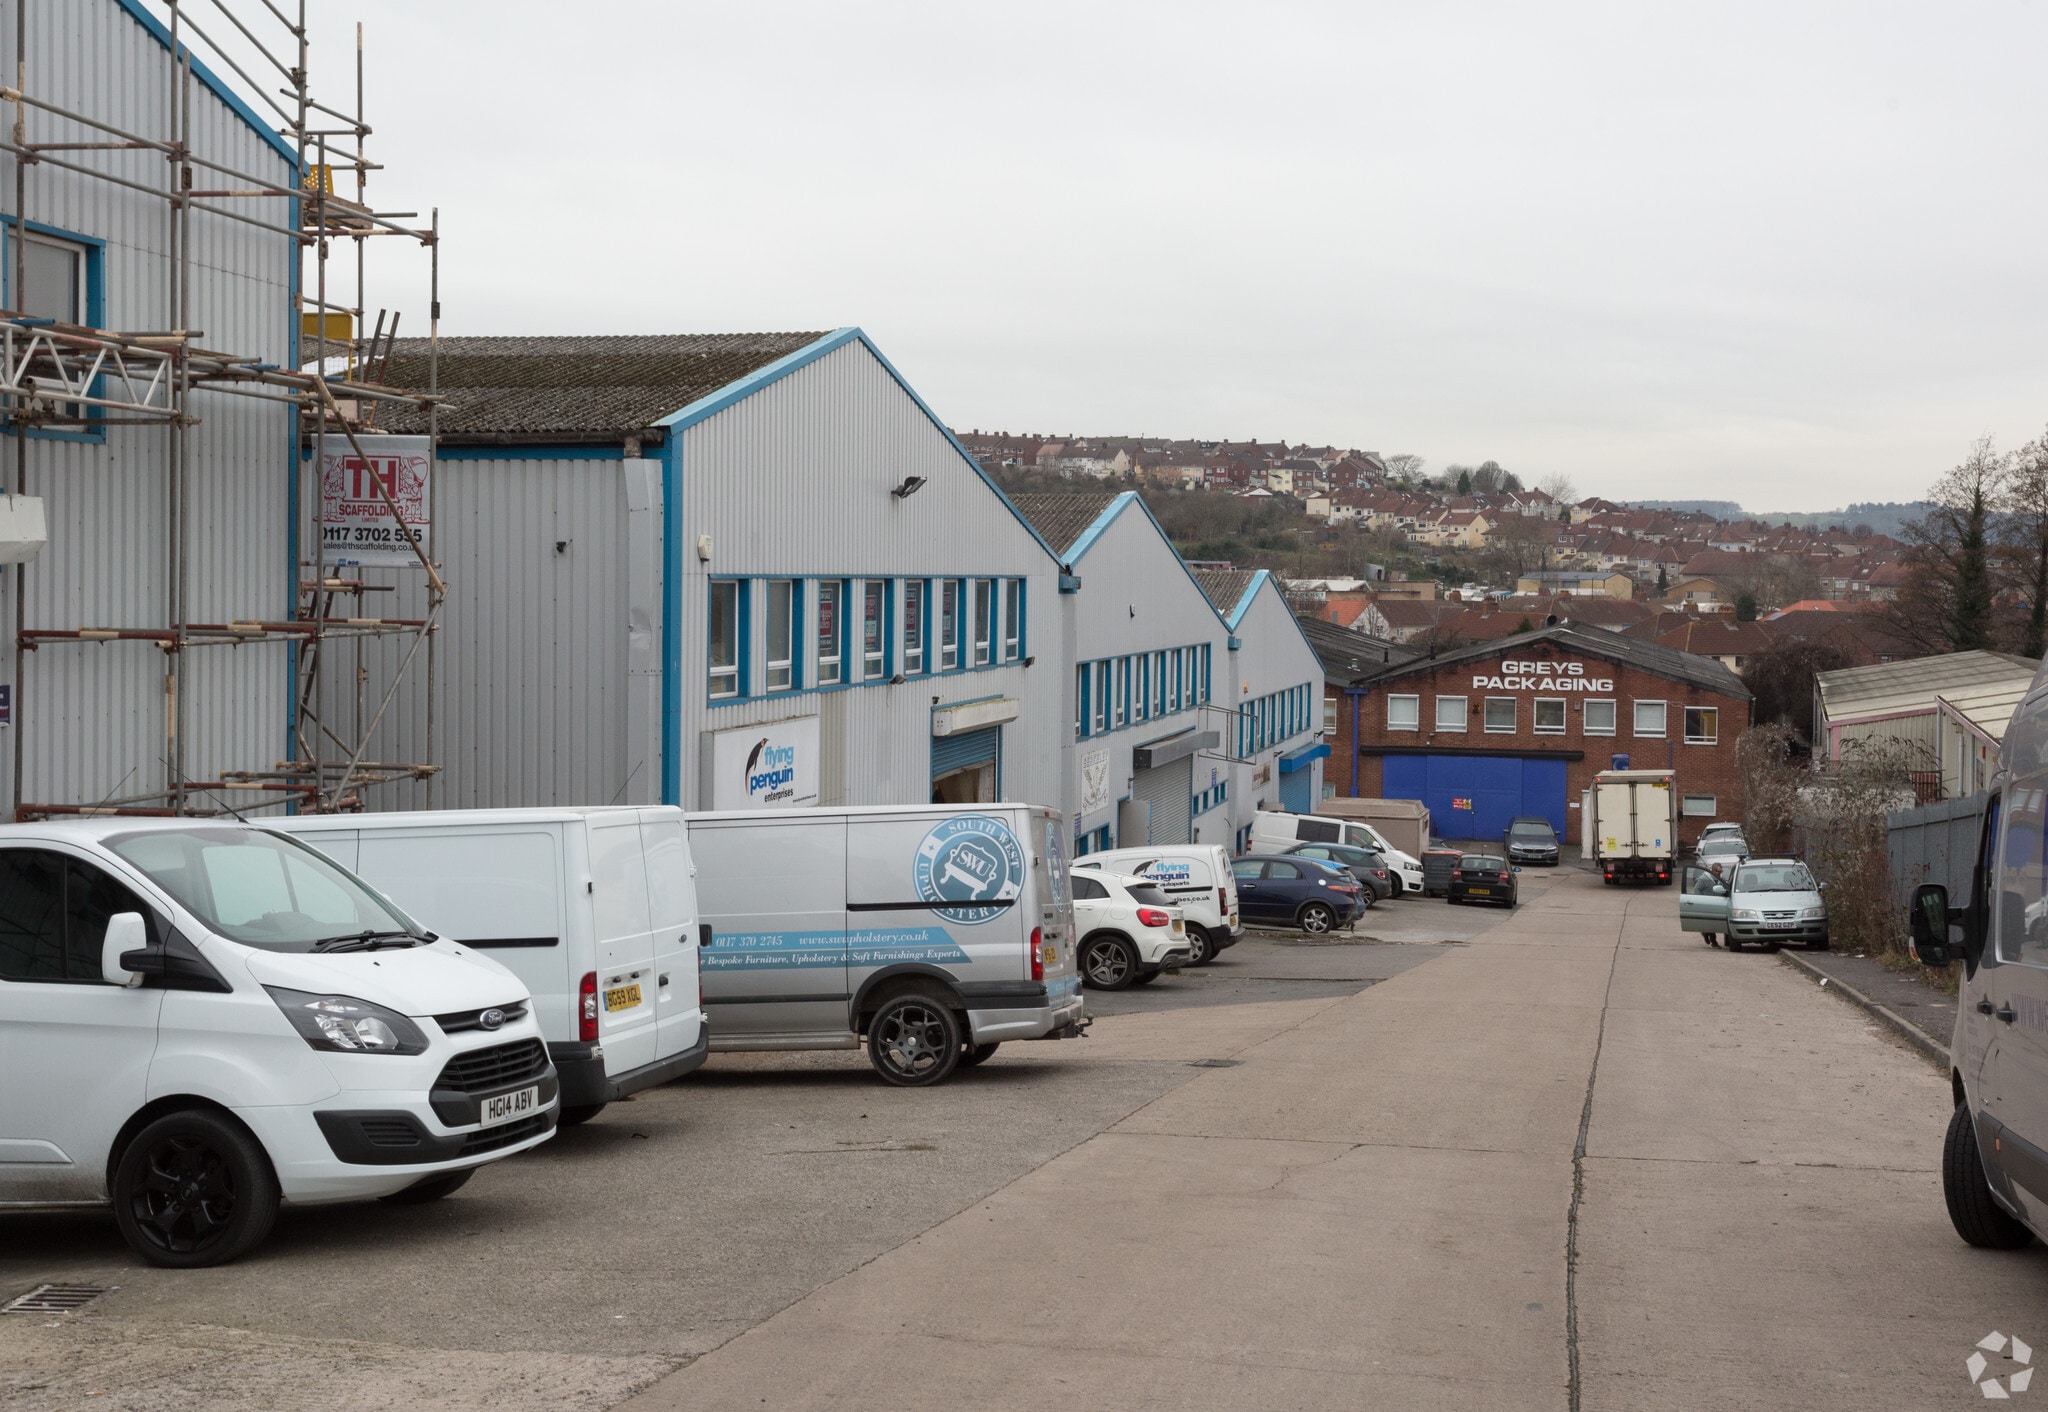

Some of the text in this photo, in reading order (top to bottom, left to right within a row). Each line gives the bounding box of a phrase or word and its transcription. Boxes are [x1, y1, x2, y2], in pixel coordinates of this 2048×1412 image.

[346, 460, 397, 499] TH
[355, 528, 391, 541] 3702
[323, 541, 416, 552] ales@thscaffolding.co.u
[1501, 660, 1584, 675] GREYS
[1472, 676, 1614, 691] PACKAGING
[764, 746, 794, 769] flying
[750, 765, 794, 796] penguin
[764, 788, 794, 803] enterprises
[948, 819, 1021, 868] SOUTH WEST
[956, 850, 992, 877] SWU
[1156, 862, 1190, 873] flying
[1140, 871, 1190, 882] enguin
[918, 863, 998, 920] UPHOSTER
[715, 930, 929, 947] 0117 370 2745 www.swupholstery.co.uk
[708, 956, 743, 967] Bespoke
[745, 955, 789, 965] Furniture,
[792, 953, 838, 964] Upholstery
[852, 952, 870, 961] Soft
[873, 950, 924, 961] Furnishings
[926, 949, 961, 959] Experts
[606, 986, 641, 1008] BG59 XGL
[489, 1089, 533, 1119] HG14 ABV
